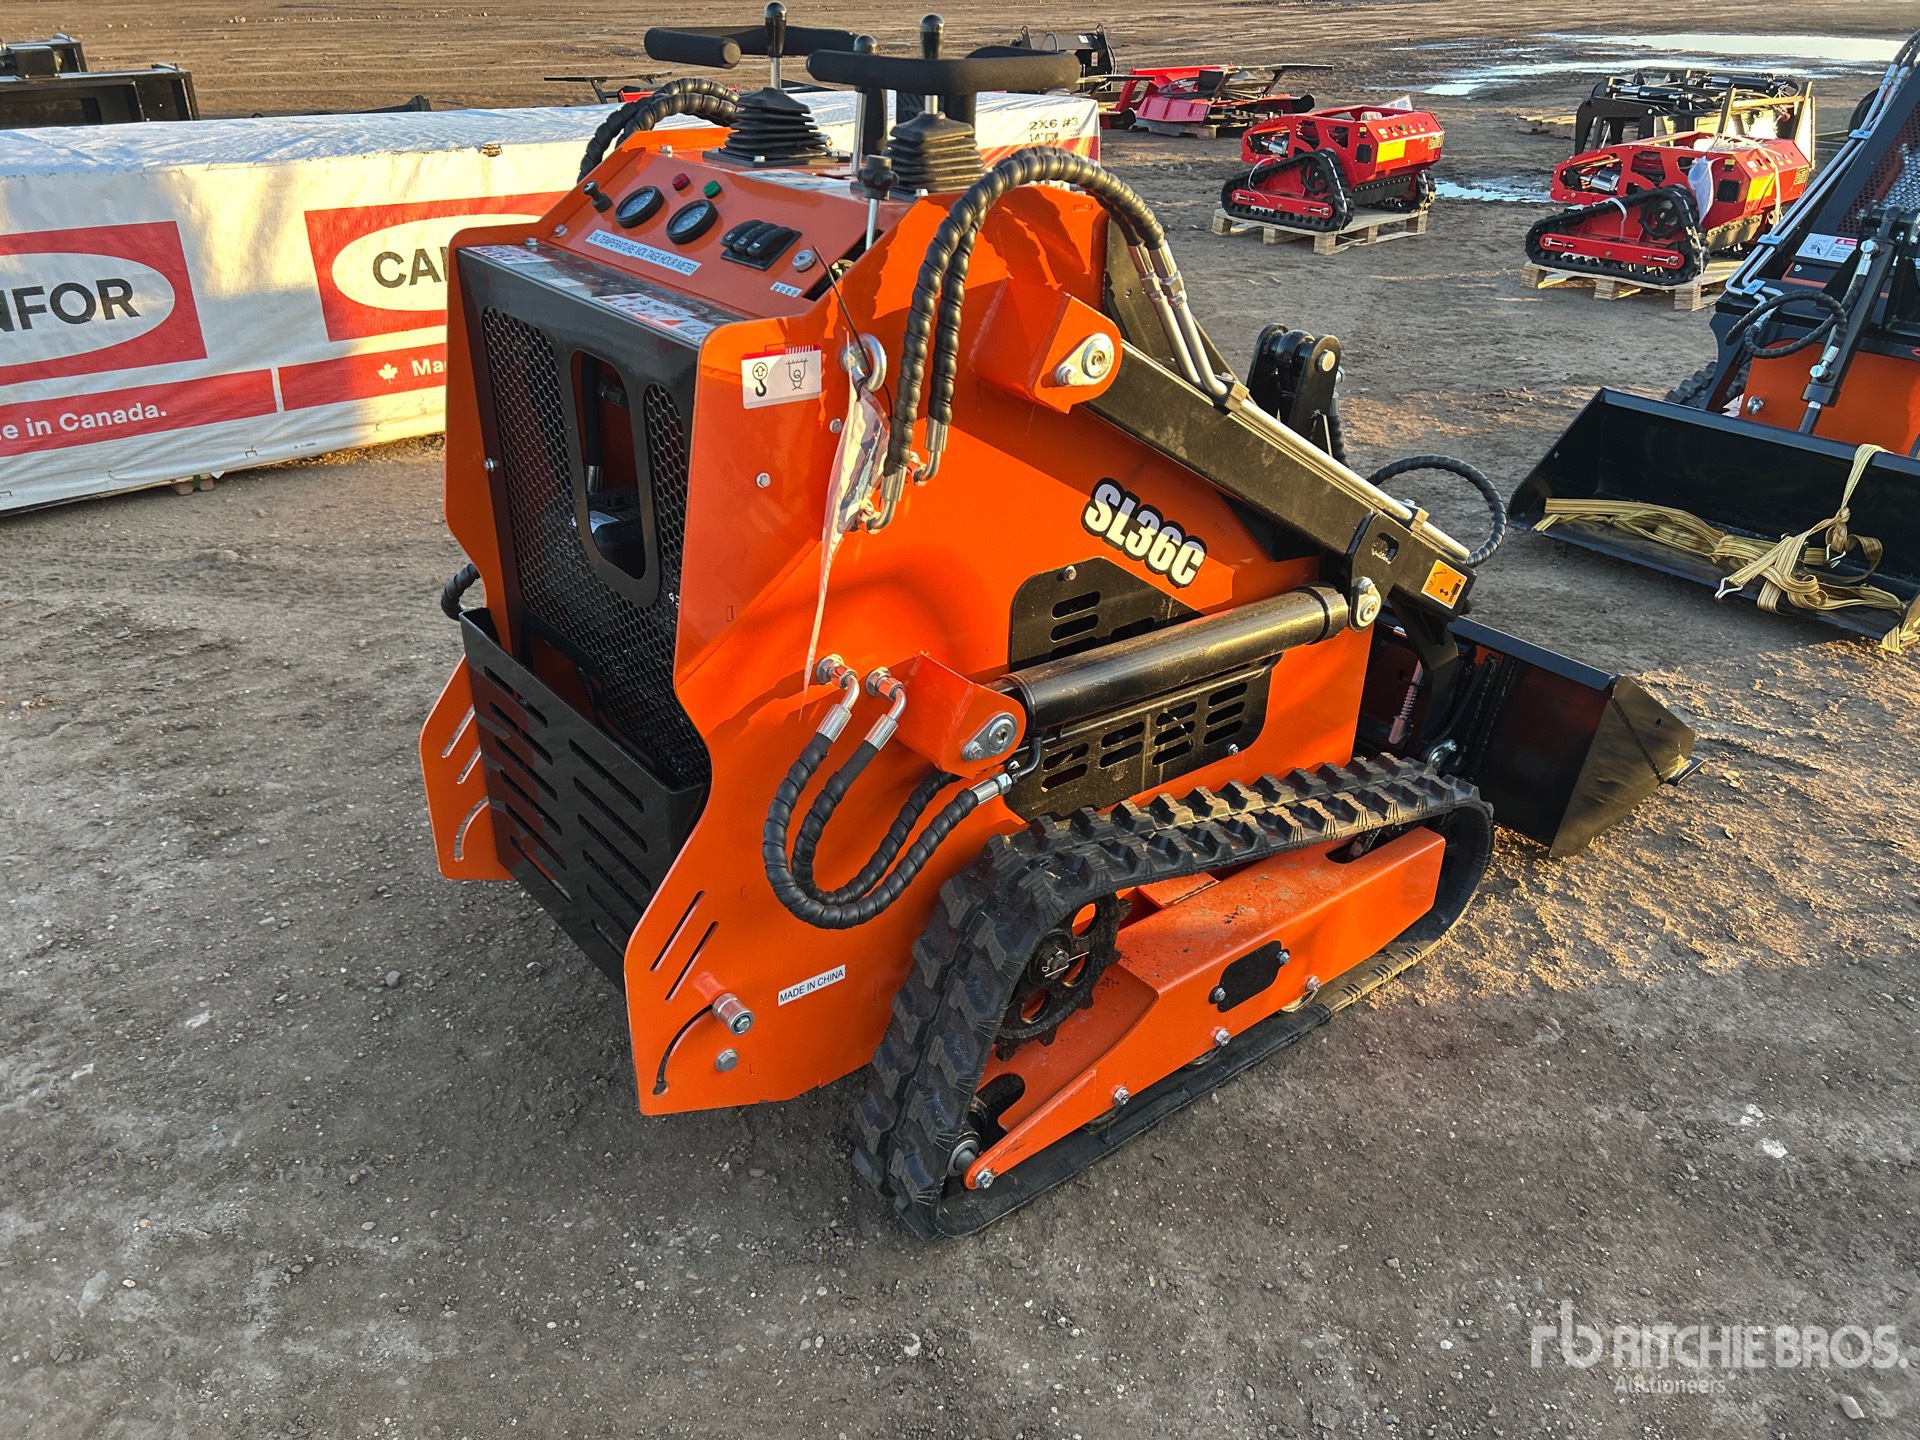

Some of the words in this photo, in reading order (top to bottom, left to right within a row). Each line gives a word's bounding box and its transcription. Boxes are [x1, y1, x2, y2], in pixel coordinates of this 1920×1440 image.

[1029, 119, 1057, 131] 2X6
[598, 234, 638, 254] TEMPERATURE
[634, 246, 663, 262] VOLTAGE
[658, 254, 679, 268] HOUR
[674, 259, 698, 274] METER
[411, 358, 447, 377] Ma
[25, 417, 53, 437] in
[59, 402, 167, 432] Canada.
[1083, 480, 1206, 587] SL36C
[780, 984, 805, 1002] MADE
[807, 981, 816, 992] IN
[817, 969, 844, 987] CHINA
